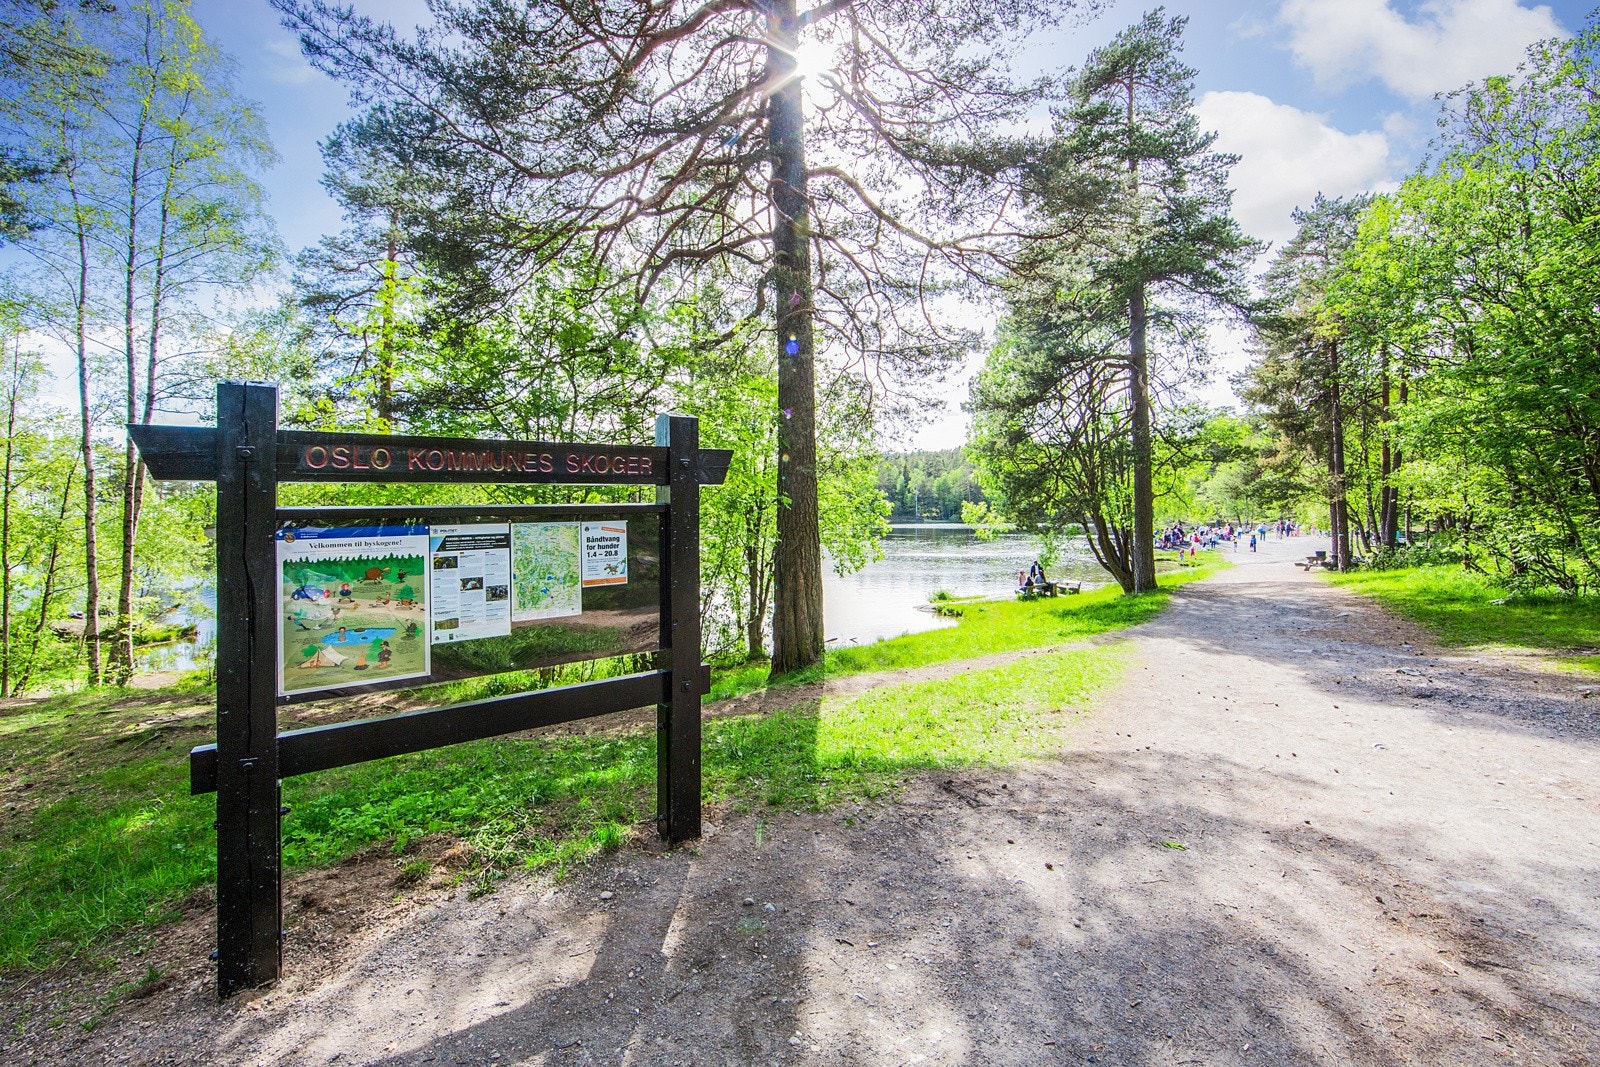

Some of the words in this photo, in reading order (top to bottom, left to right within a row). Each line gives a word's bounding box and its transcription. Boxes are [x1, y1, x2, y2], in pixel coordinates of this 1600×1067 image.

[305, 445, 392, 470] OSLO
[407, 447, 554, 473] KOMMUNES
[566, 453, 653, 474] SKOGER
[309, 541, 353, 549] Velkommen
[364, 540, 402, 548] byskogene!
